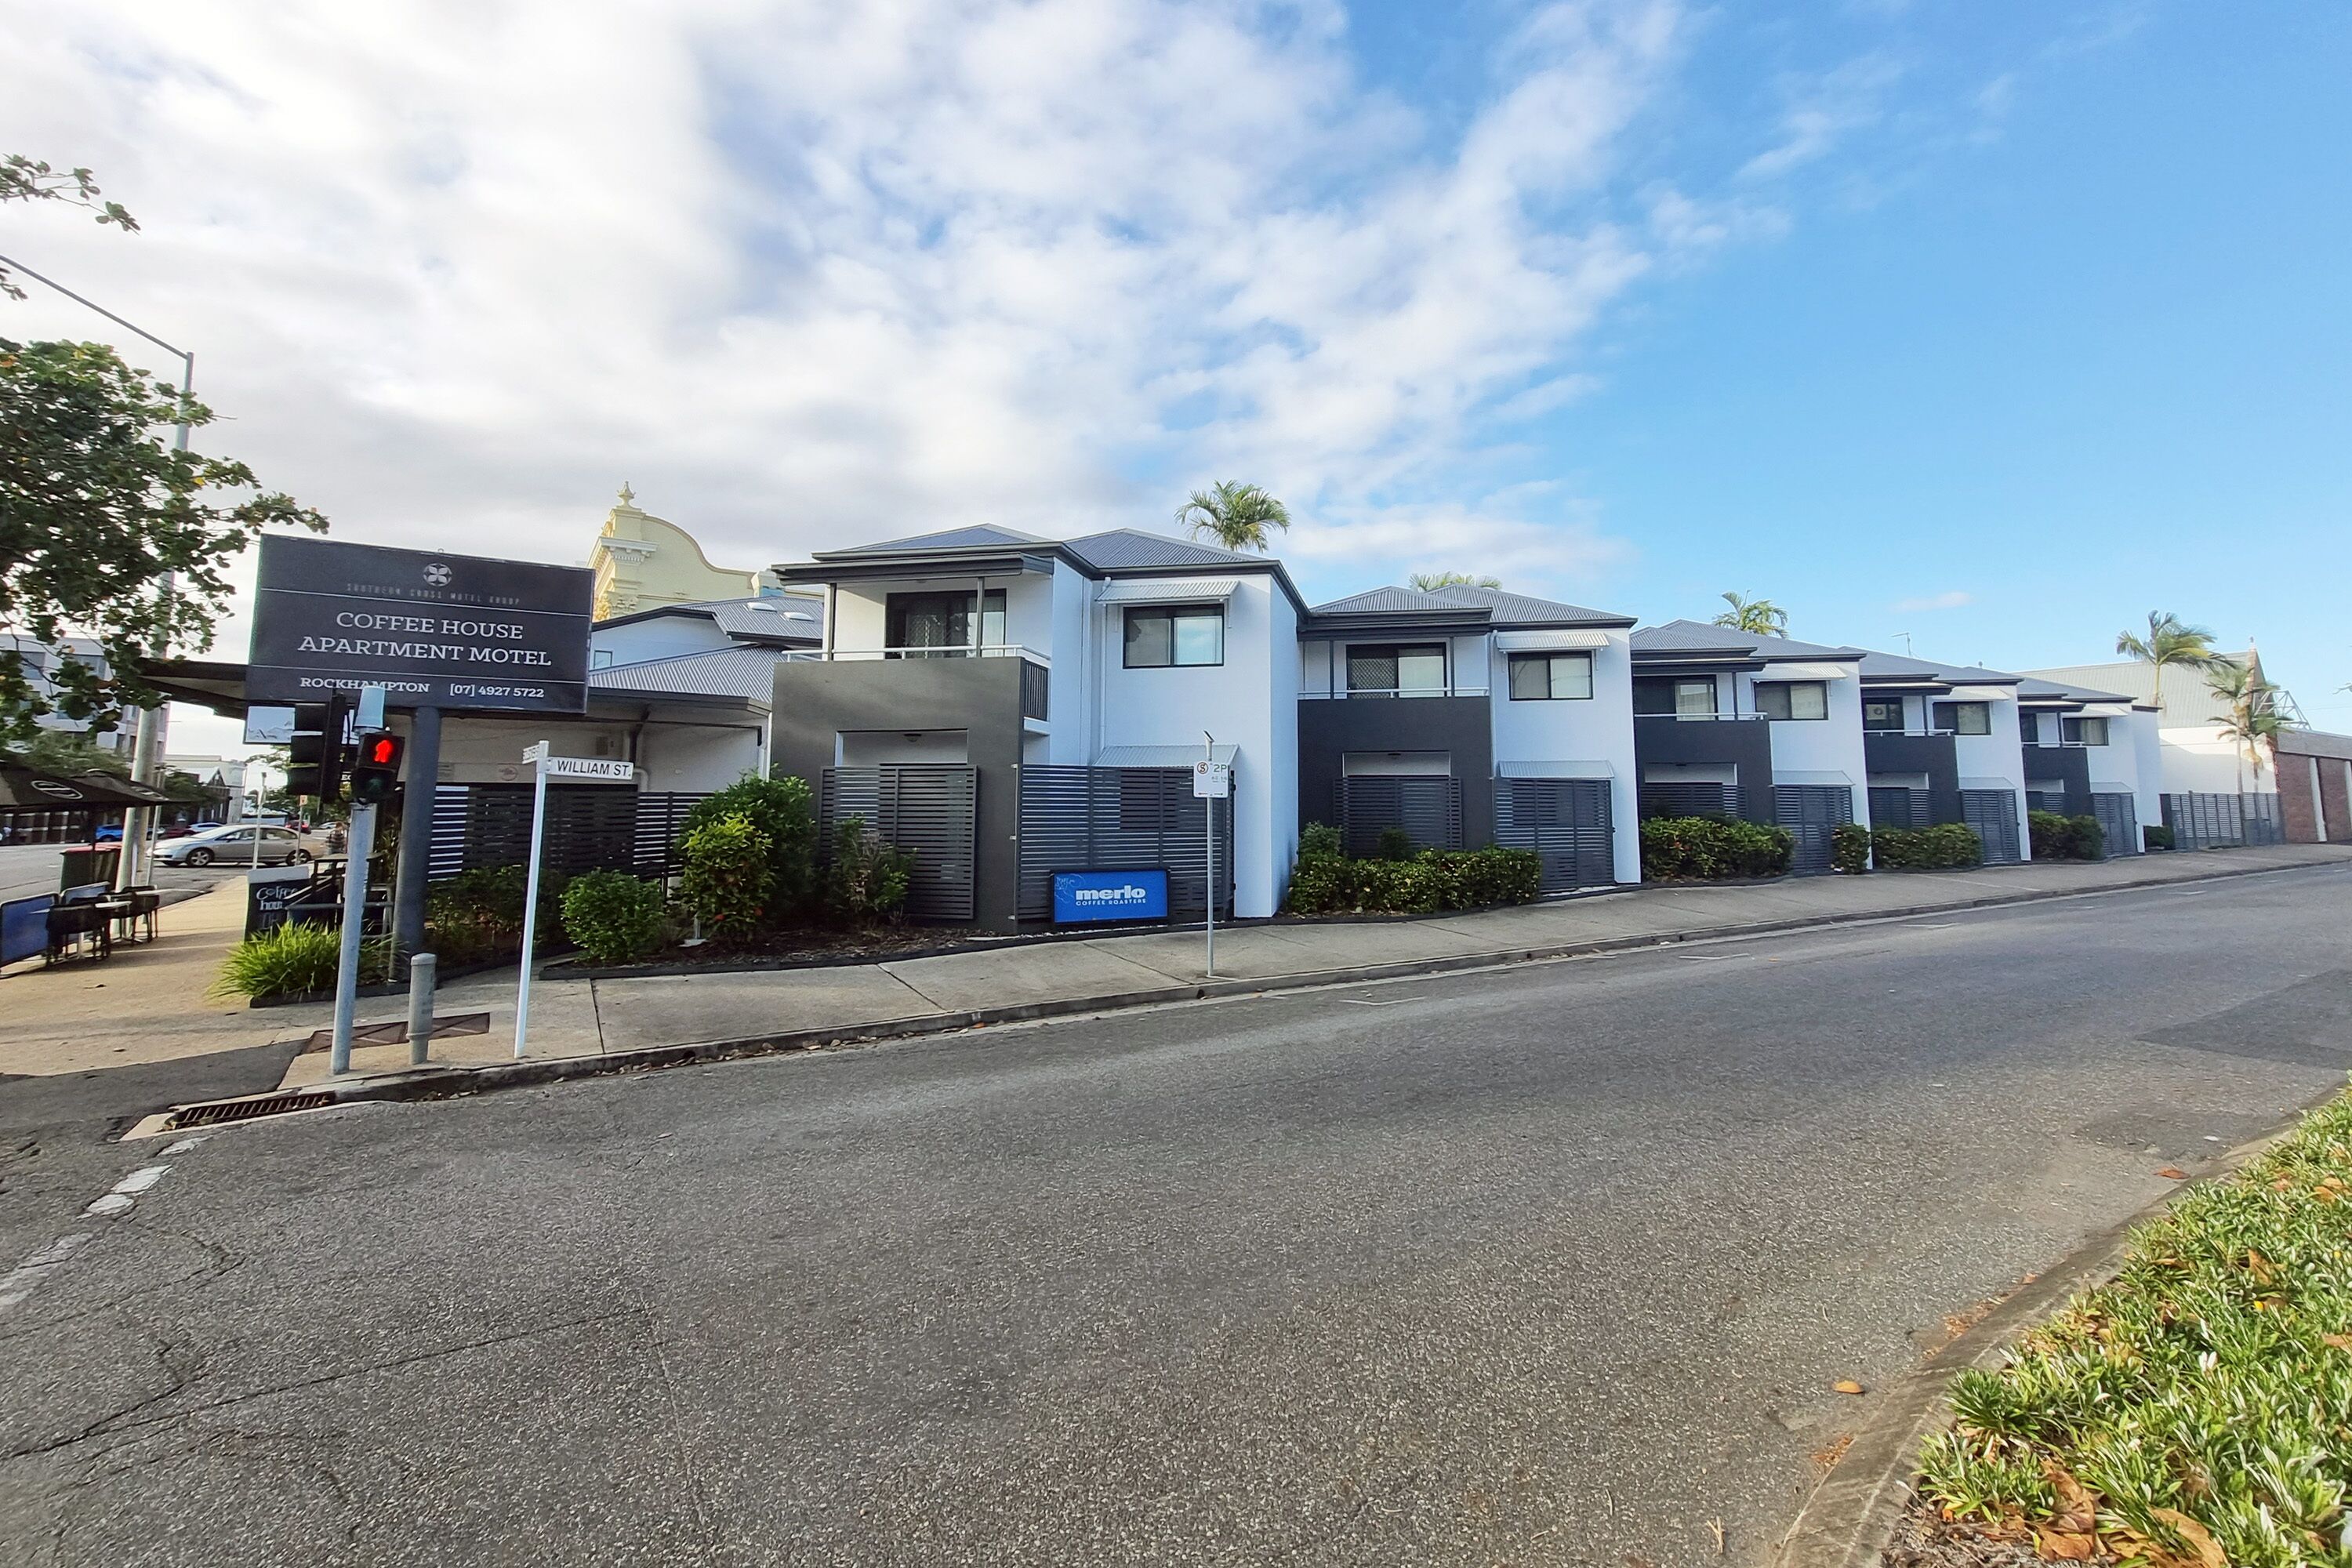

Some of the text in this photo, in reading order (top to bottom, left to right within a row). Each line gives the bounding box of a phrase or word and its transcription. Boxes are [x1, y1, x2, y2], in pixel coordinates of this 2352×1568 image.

[336, 612, 523, 639] COFFEE HOUSE
[297, 636, 552, 666] APARTMENT MOTEL
[299, 677, 545, 698] ROCKHAMPTON [07] 4927 5722
[557, 760, 610, 775] WILLIAM
[1214, 764, 1227, 772] 2P
[1076, 885, 1145, 900] merlo
